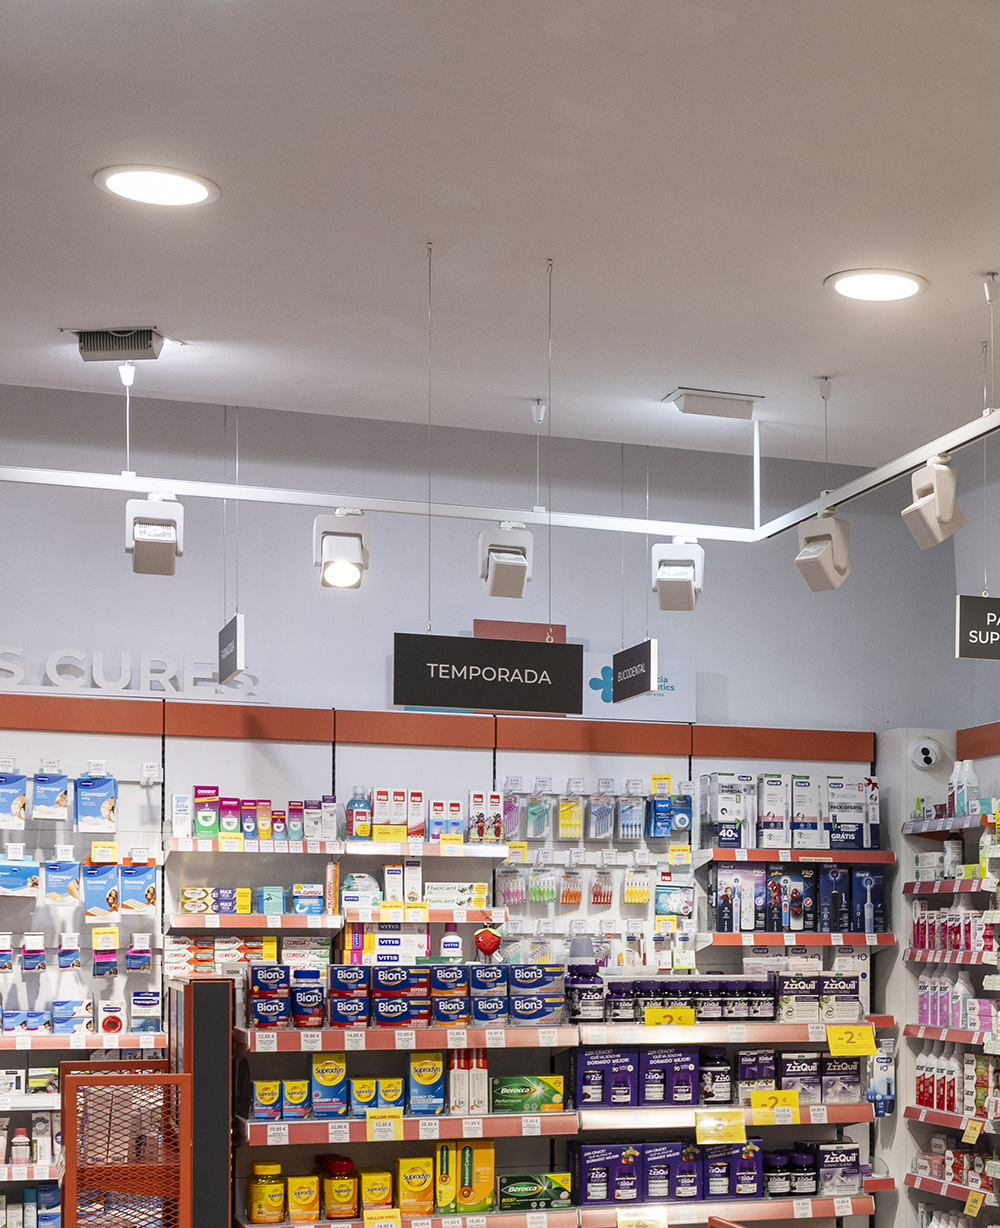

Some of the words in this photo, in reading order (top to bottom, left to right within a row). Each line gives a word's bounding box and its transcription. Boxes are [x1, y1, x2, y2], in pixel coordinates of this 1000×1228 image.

[426, 663, 552, 685] TEMPORADA
[617, 662, 646, 682] BUCODENTAL
[257, 970, 285, 980] Bion3
[337, 969, 364, 980] Bion3
[378, 970, 407, 981] Bion3
[437, 969, 463, 979] Bion3
[476, 968, 502, 979] Bion3
[514, 968, 544, 979] Bion3
[783, 981, 817, 990] ZzzQuil
[823, 981, 857, 990] ZzzQuil
[296, 992, 323, 1003] Bion3
[257, 1002, 285, 1012] Bion3
[337, 1002, 364, 1012] Bion3
[378, 1002, 408, 1013] Bion3
[439, 1001, 465, 1011] Bion3
[478, 1000, 504, 1010] Bion3
[513, 1000, 543, 1011] Bion3
[838, 1031, 856, 1044] -2
[315, 1066, 344, 1076] Supradyn
[413, 1065, 441, 1075] Supradyn
[785, 1062, 818, 1072] ZzzQuil
[822, 1061, 856, 1071] ZzzQuil
[256, 1090, 279, 1098] Supradyn
[353, 1087, 376, 1096] Supradyn
[380, 1087, 402, 1095] Supradyn
[499, 1087, 531, 1095] Berocca
[824, 1153, 857, 1163] ZzzQuil
[403, 1172, 431, 1182] Supradyn
[292, 1189, 316, 1198] Supradyn
[508, 1185, 538, 1194] Berocca
